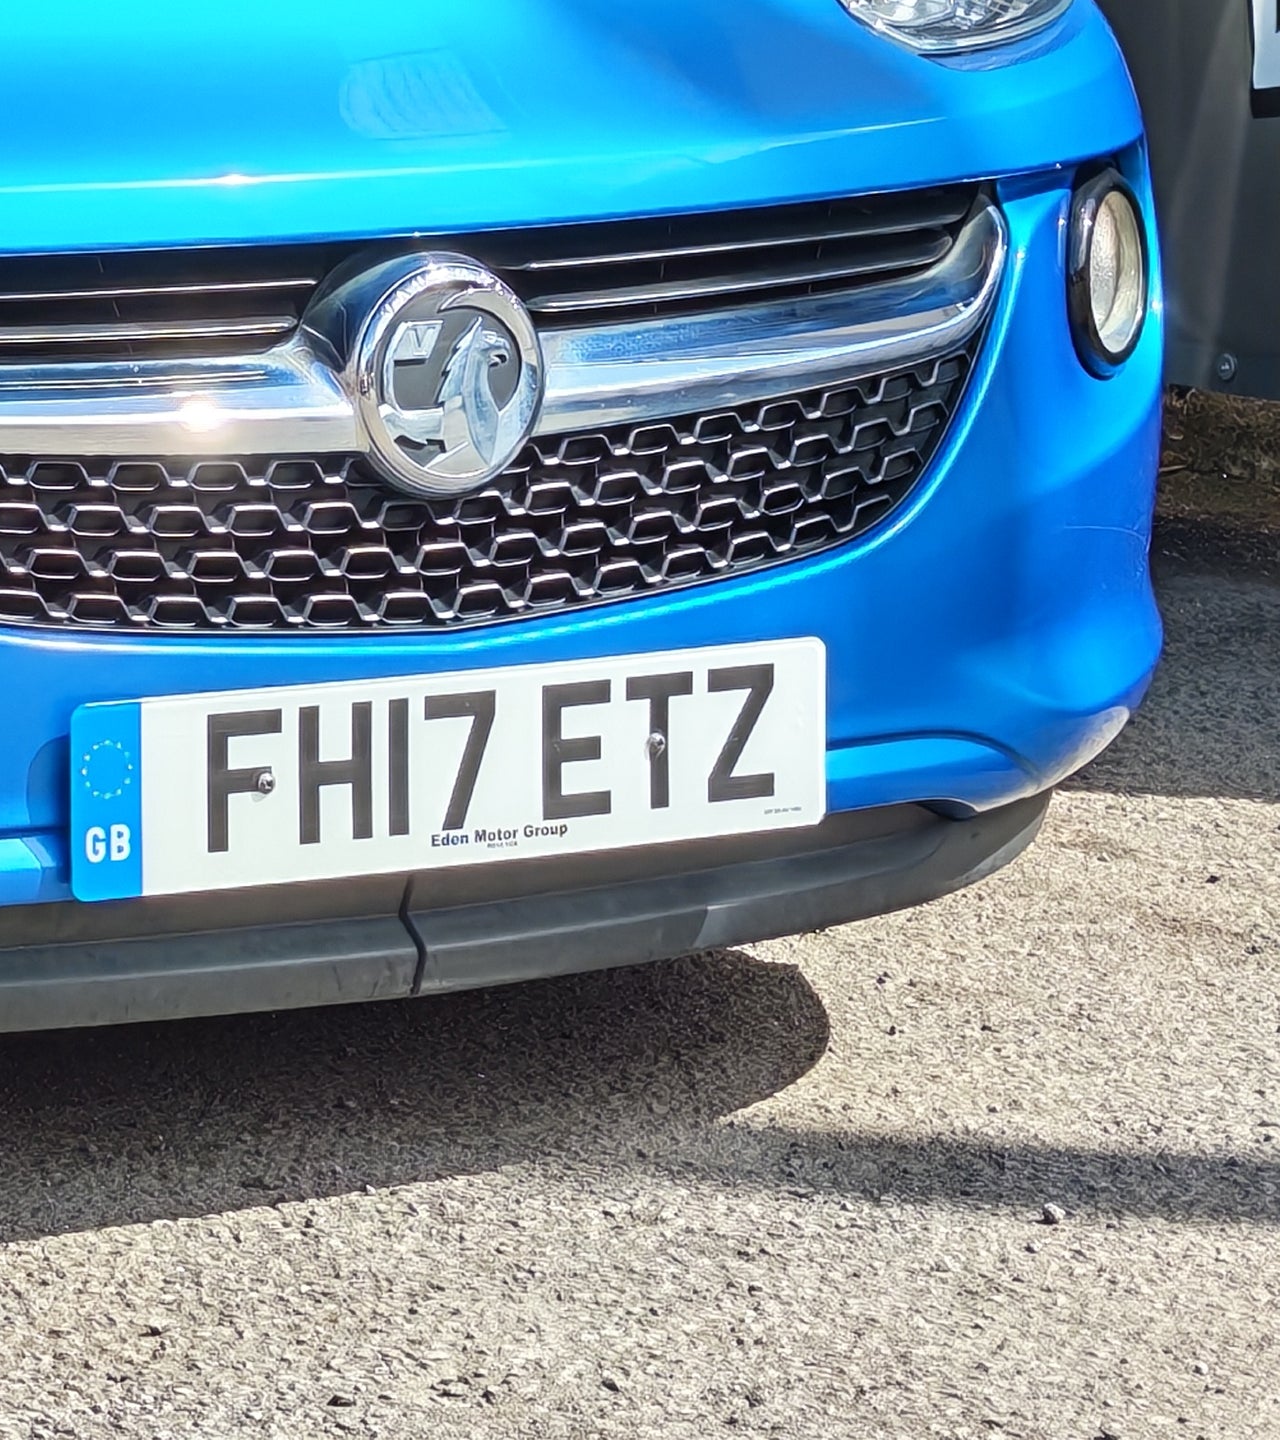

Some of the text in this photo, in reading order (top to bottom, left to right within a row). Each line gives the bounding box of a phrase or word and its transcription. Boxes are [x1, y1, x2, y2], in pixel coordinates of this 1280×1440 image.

[207, 663, 775, 853] FH17 ETZ
[85, 823, 131, 864] GB
[431, 832, 469, 847] Eden
[474, 827, 519, 843] Motor
[523, 823, 568, 838] Group
